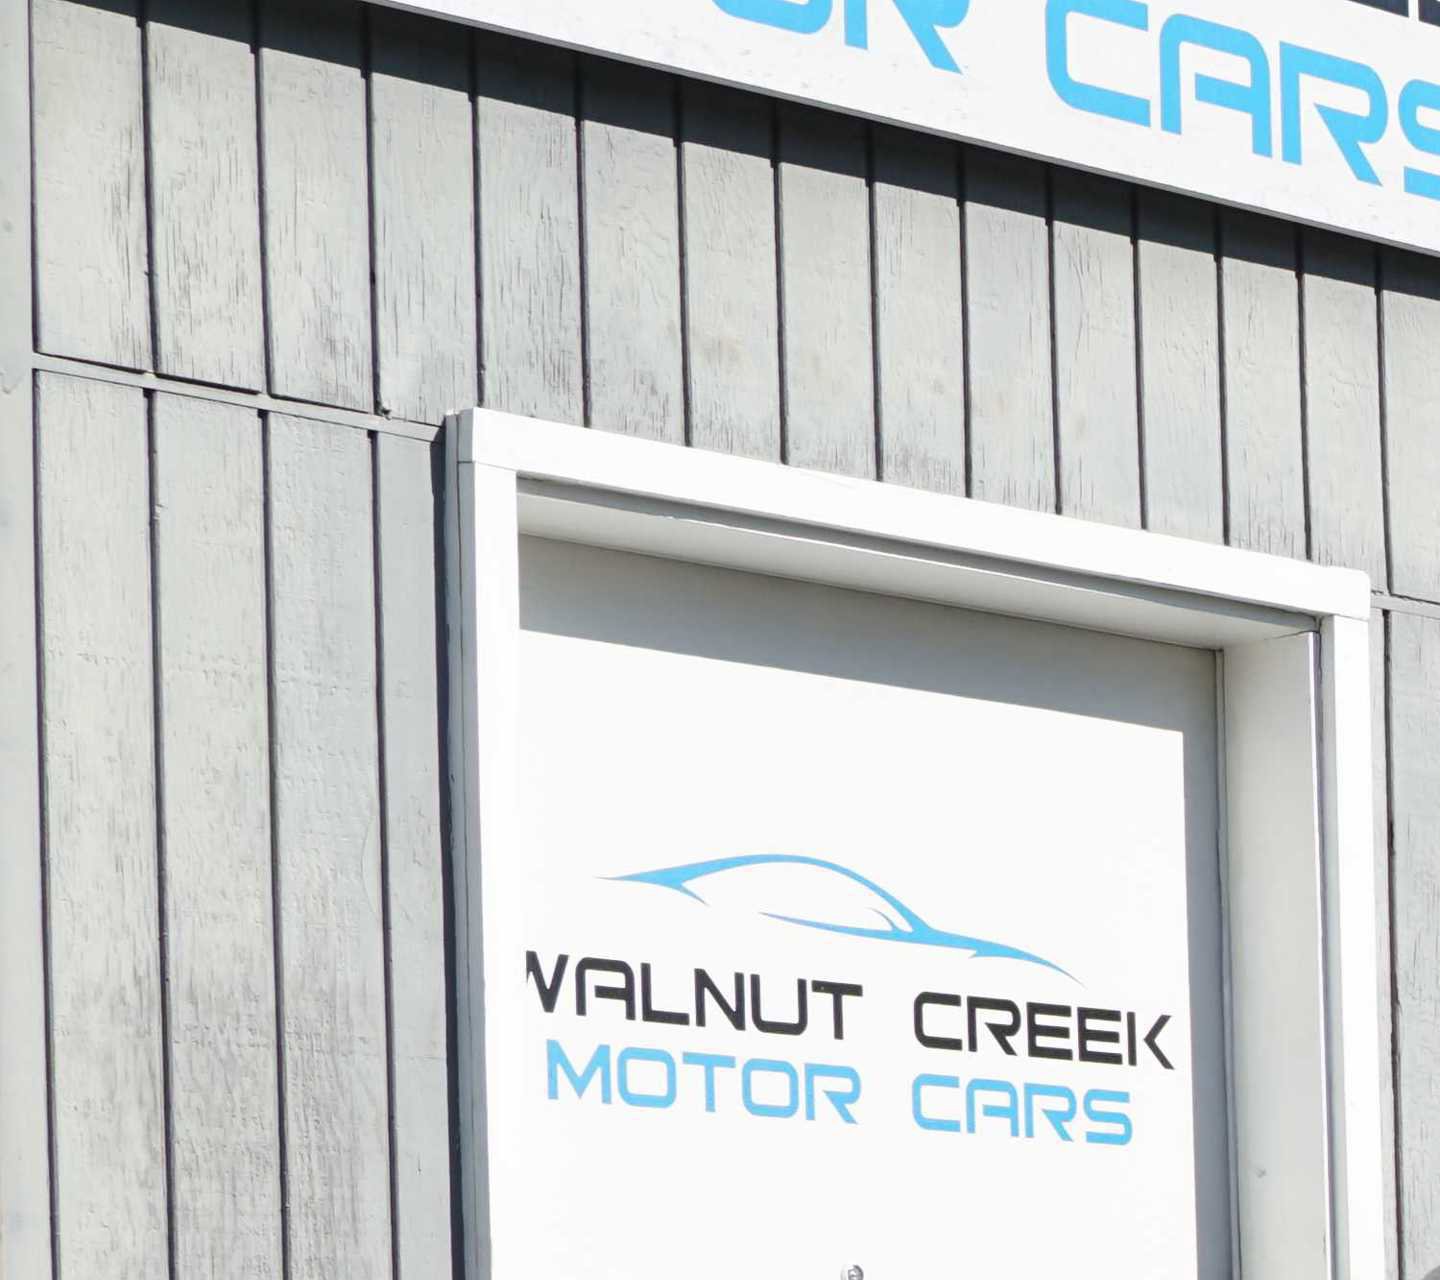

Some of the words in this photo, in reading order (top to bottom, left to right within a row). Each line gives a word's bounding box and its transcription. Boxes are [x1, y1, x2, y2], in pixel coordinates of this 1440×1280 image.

[526, 950, 862, 1041] WALNUT
[914, 990, 1175, 1070] CREEK
[546, 1038, 862, 1125] MOTOR
[912, 1074, 1134, 1146] CARS
